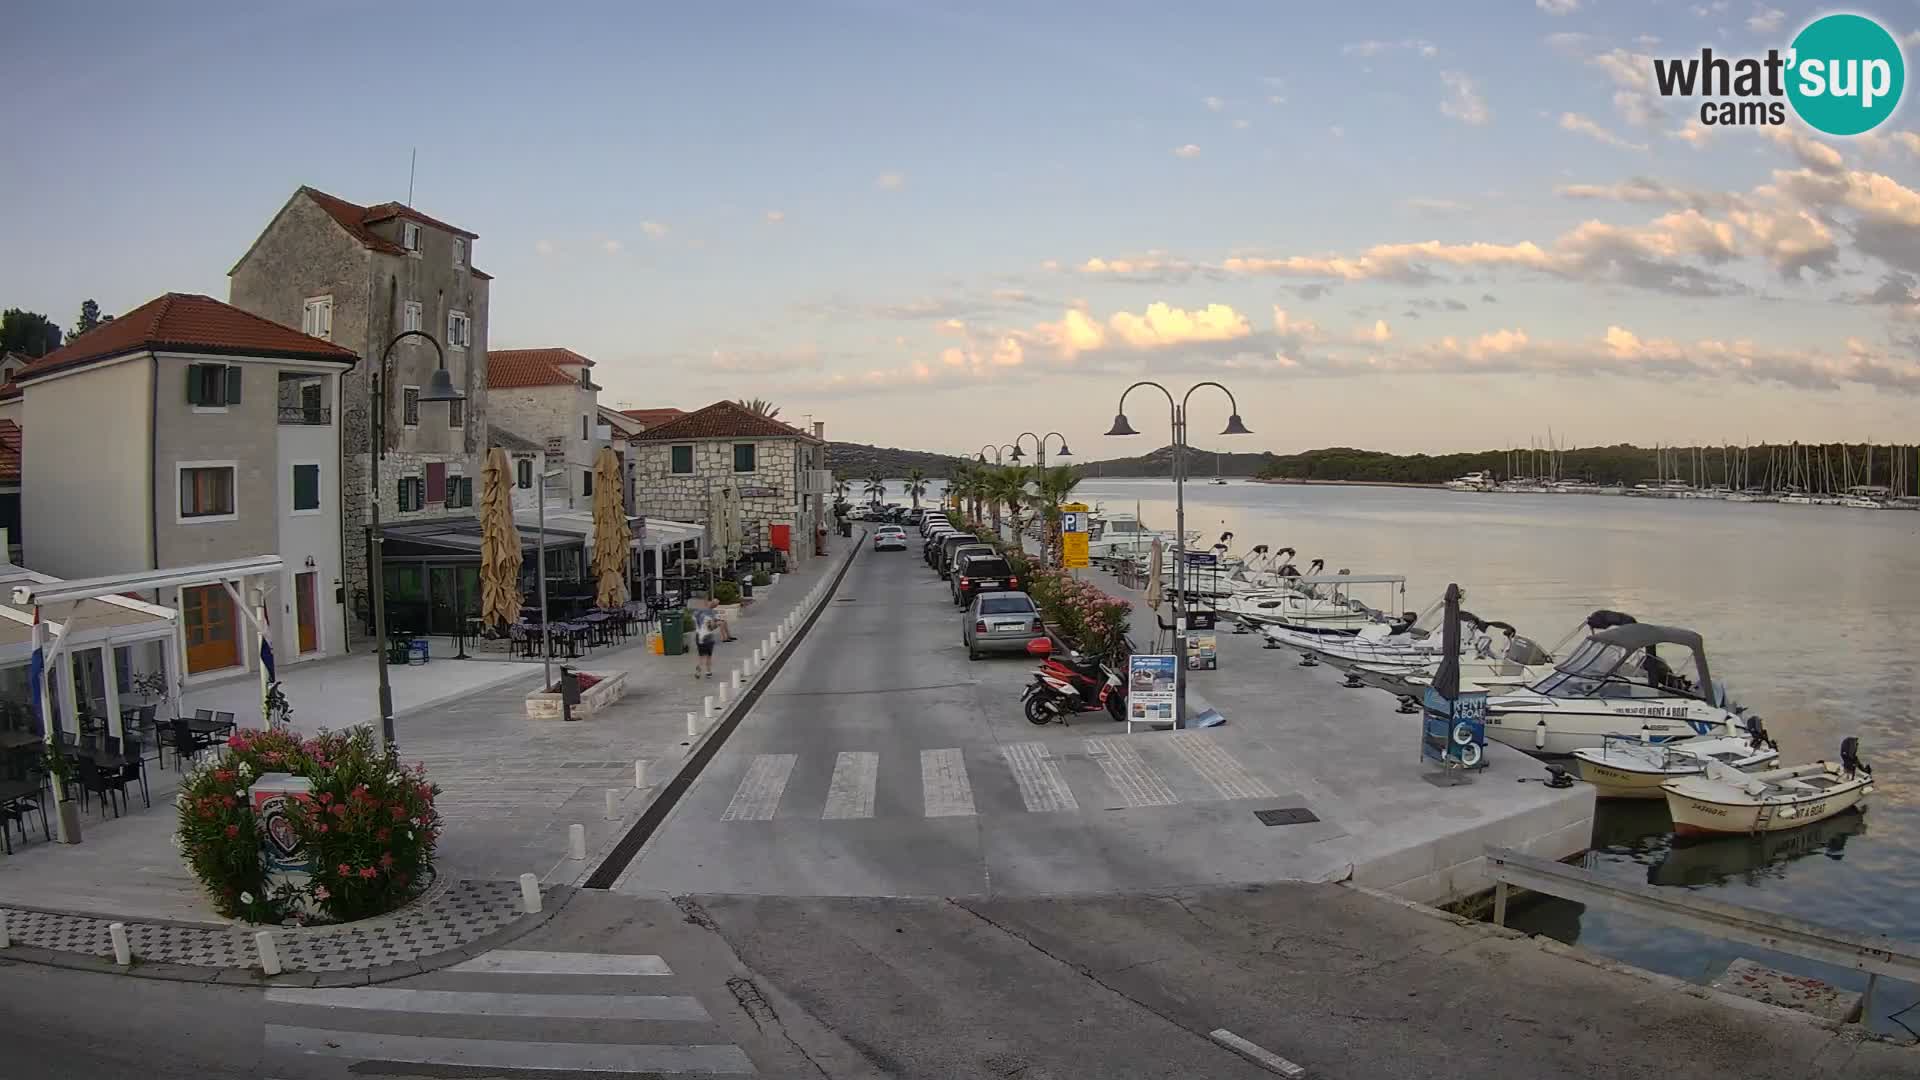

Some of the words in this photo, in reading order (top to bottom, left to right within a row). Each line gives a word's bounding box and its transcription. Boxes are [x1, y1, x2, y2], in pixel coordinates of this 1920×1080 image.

[1065, 514, 1076, 530] P
[1453, 697, 1486, 710] RENT
[1452, 711, 1460, 719] A
[1461, 708, 1483, 719] BOAT
